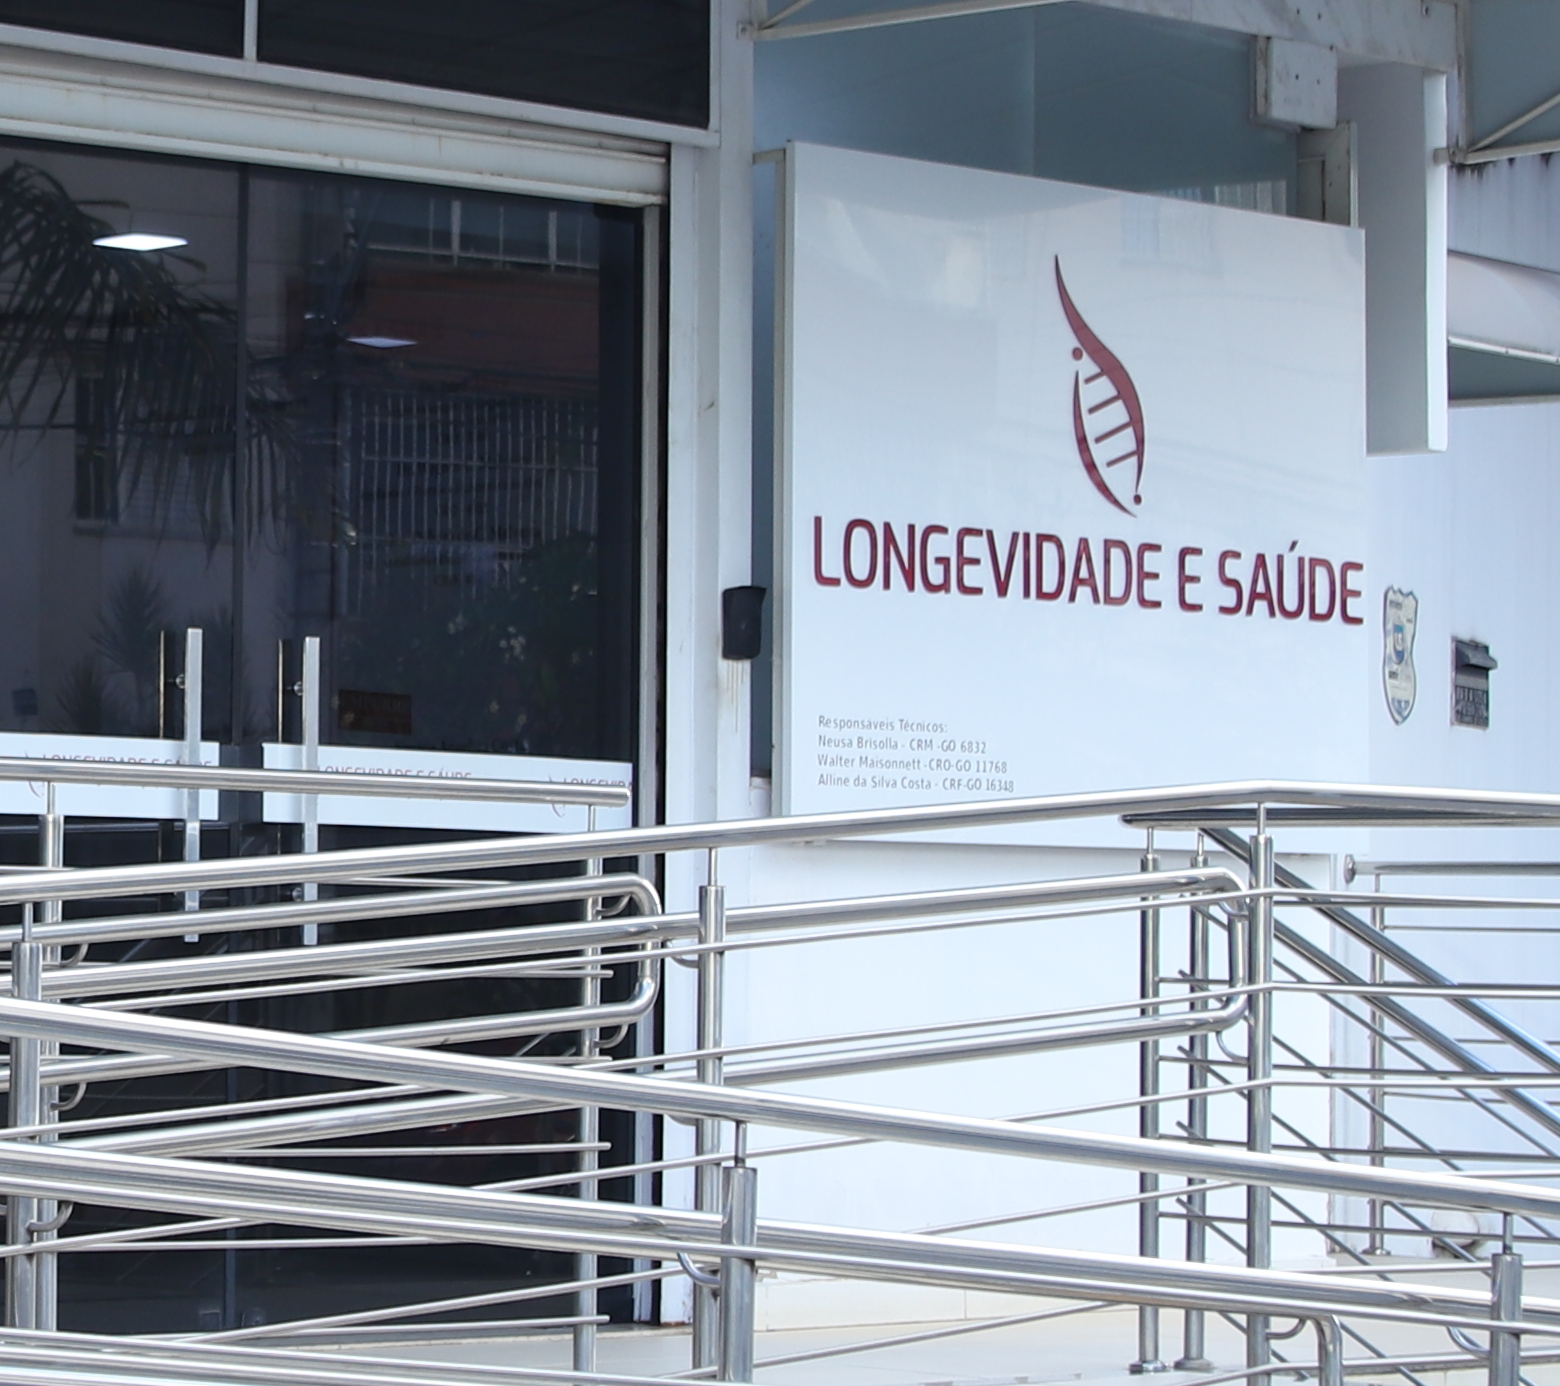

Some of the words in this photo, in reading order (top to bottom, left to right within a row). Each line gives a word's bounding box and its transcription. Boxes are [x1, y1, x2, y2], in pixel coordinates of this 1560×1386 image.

[813, 515, 1162, 609] LONGEVIDADE
[1178, 546, 1203, 612] E
[1218, 539, 1364, 625] SAÚDE
[898, 718, 948, 734] Técnicos:
[818, 734, 853, 749] Neusa
[857, 736, 898, 751] Brisolla
[909, 738, 933, 752] CRM
[960, 740, 987, 755] 6832
[817, 753, 856, 768] Walter
[859, 755, 921, 770] Maisonnett
[975, 760, 1008, 774] 11768
[817, 773, 850, 787] Alline
[853, 774, 867, 788] da
[871, 775, 897, 789] Silva
[901, 776, 932, 791] Costa
[942, 777, 983, 792] CRF-GO
